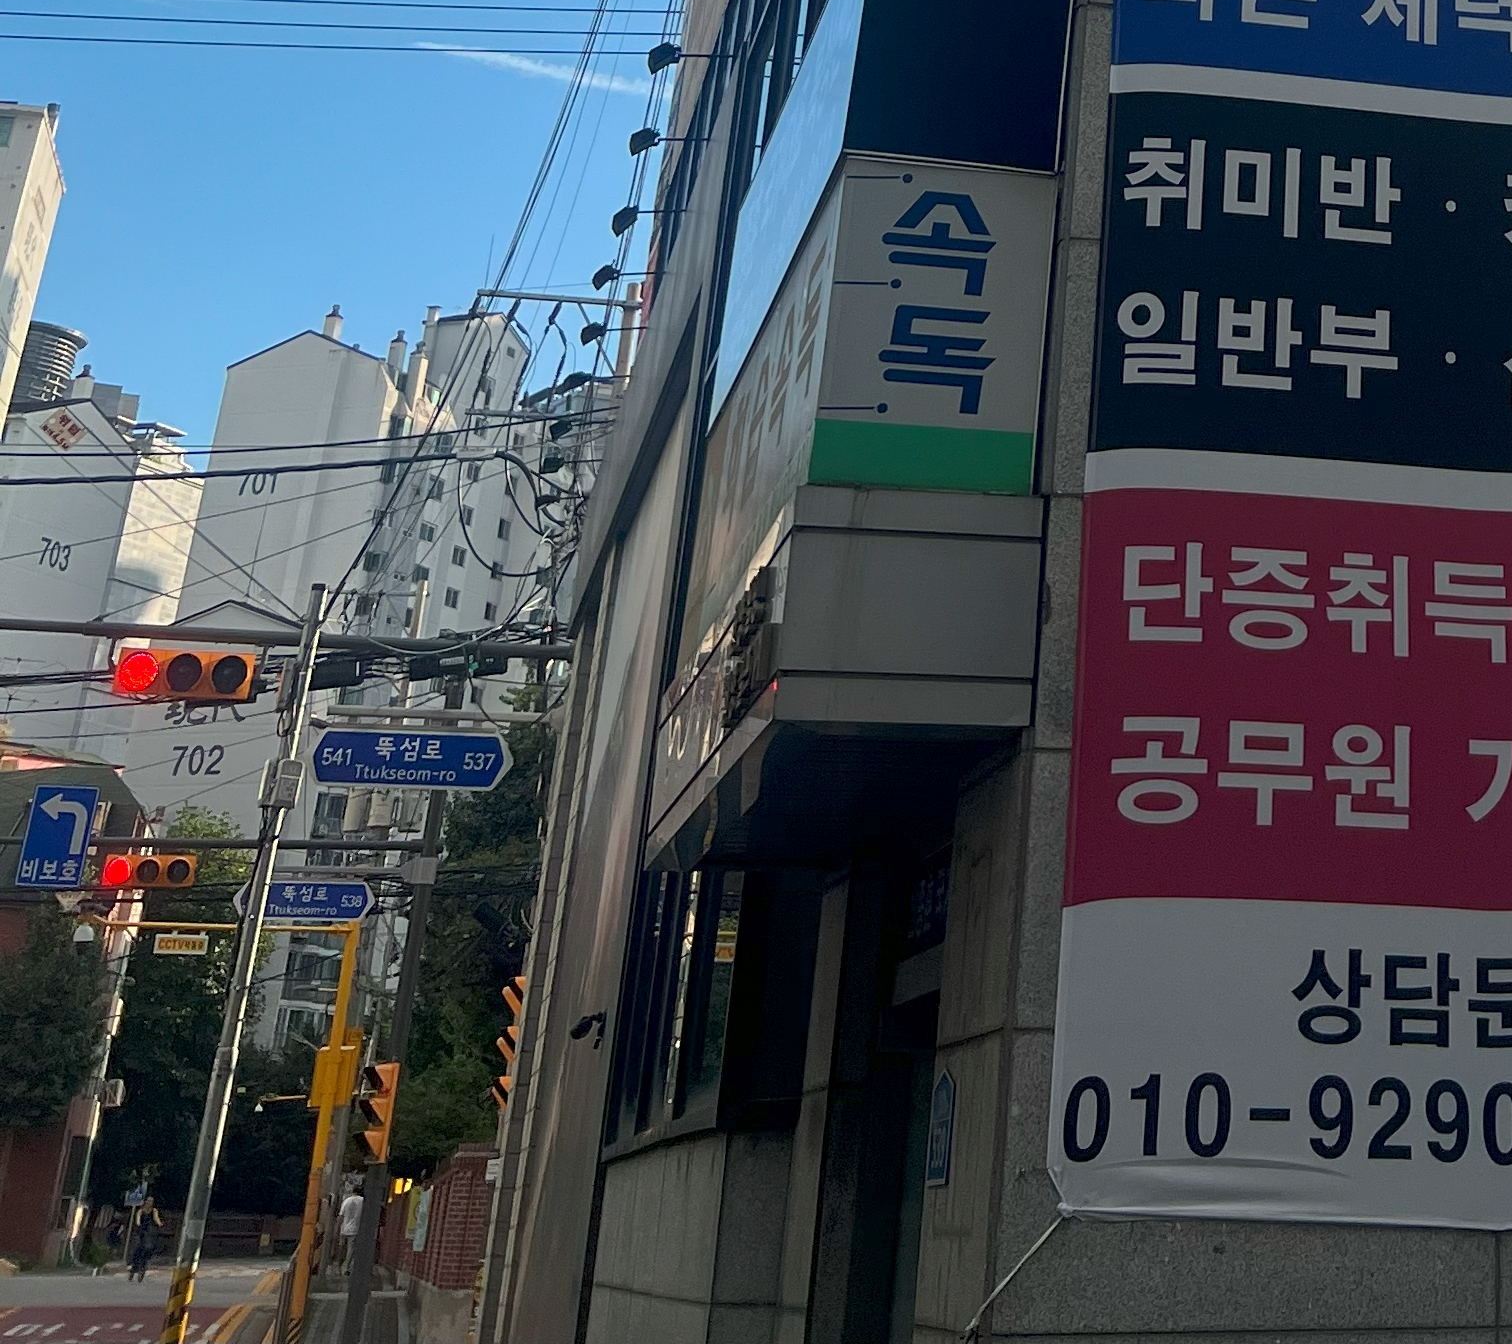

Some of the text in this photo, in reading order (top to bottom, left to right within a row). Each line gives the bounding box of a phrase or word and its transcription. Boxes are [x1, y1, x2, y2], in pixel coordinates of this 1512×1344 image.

[1123, 136, 1401, 245] 취미반
[877, 190, 998, 416] 속독
[1116, 290, 1399, 399] 일반부
[38, 536, 71, 572] 703
[171, 744, 225, 777] 702
[320, 747, 352, 767] 541
[373, 735, 444, 762] 뚝섬로
[462, 752, 497, 771] 537
[353, 763, 457, 783] Ttukseom-ro
[1110, 715, 1412, 830] 공무원
[20, 857, 79, 882] 비보호
[339, 895, 364, 908] 538
